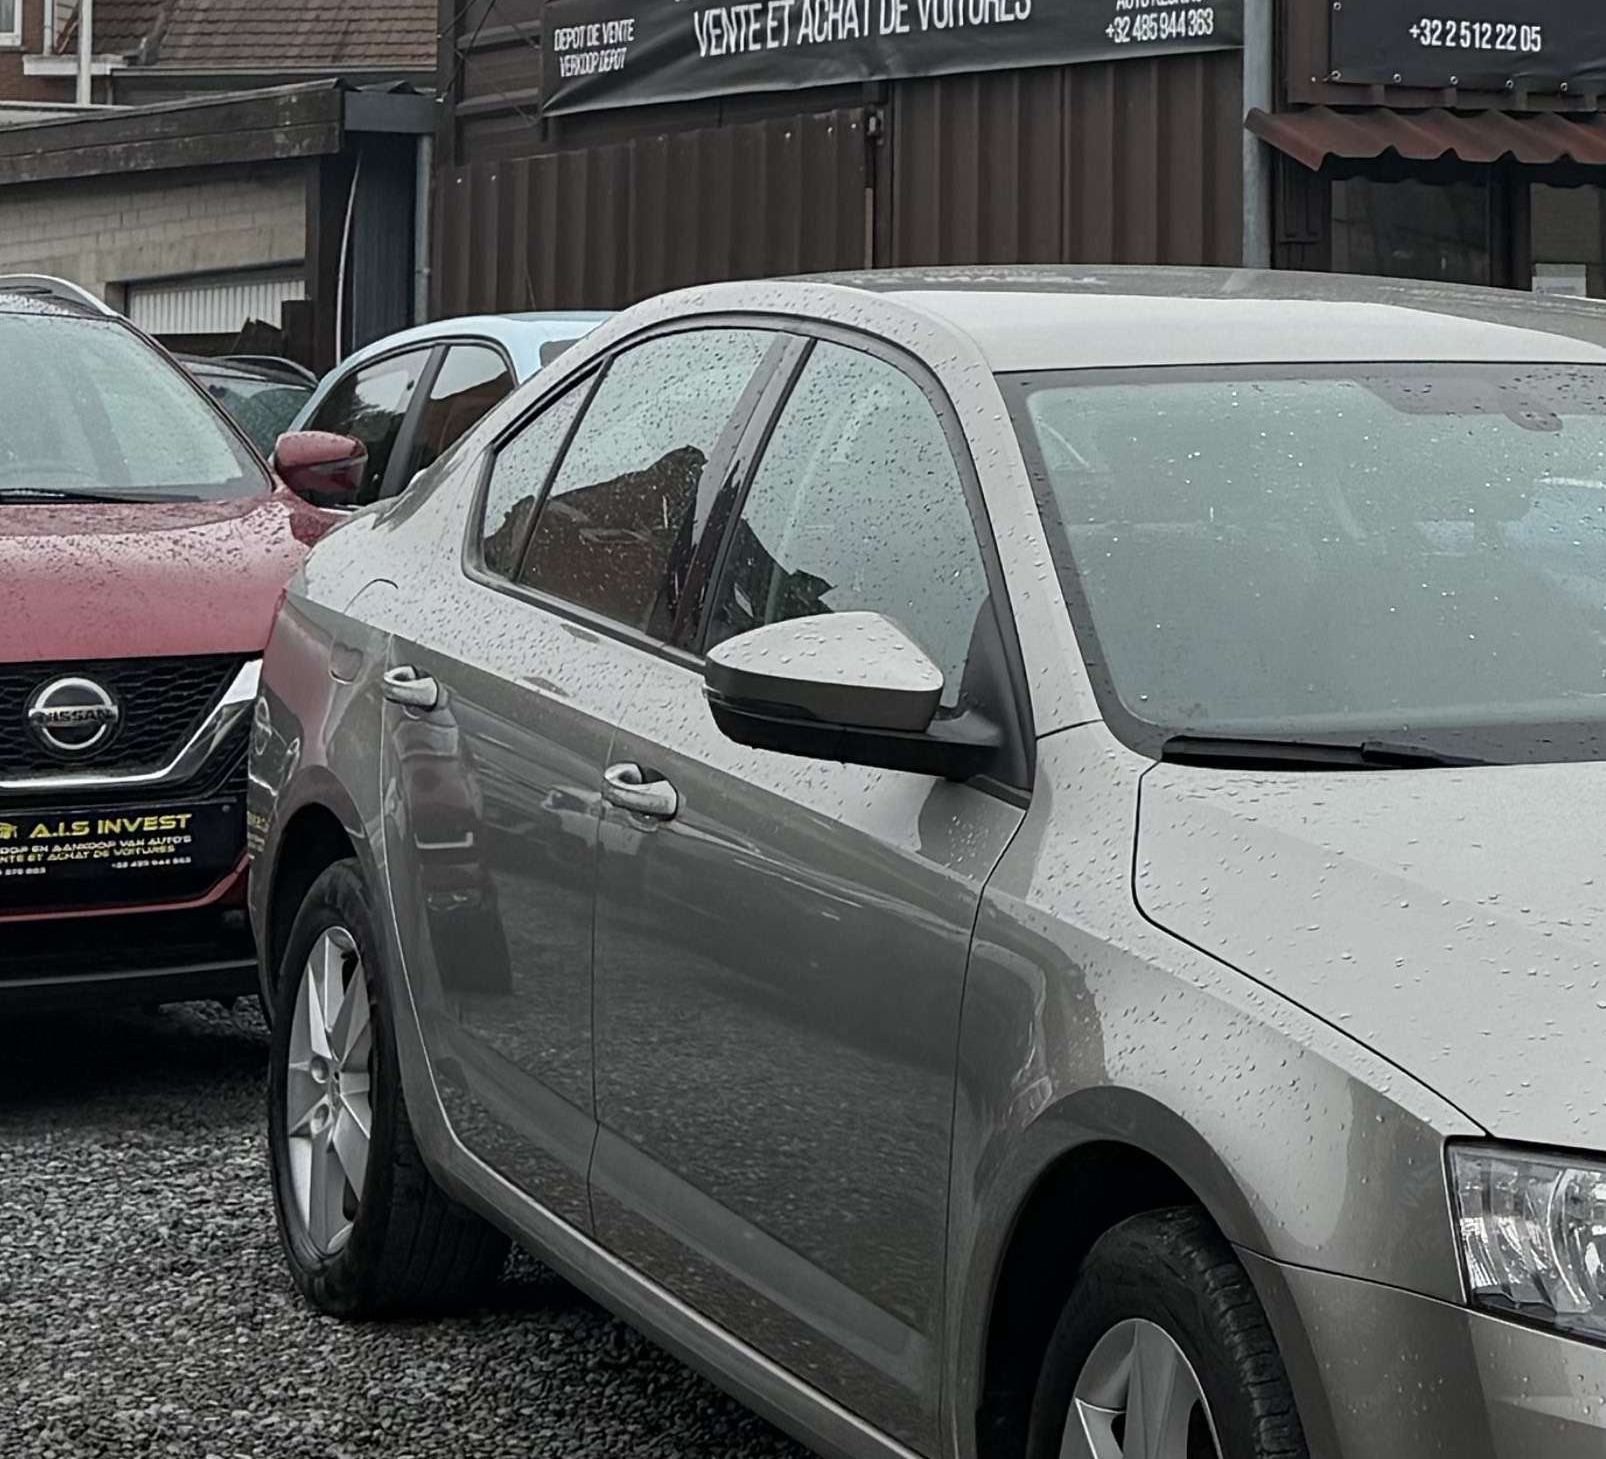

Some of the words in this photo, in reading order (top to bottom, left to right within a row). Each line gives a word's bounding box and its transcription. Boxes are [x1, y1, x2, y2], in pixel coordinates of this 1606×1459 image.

[554, 25, 586, 51] DEPOT
[587, 23, 601, 47] DE
[602, 18, 635, 44] VENTE
[694, 3, 763, 57] VENTE
[1105, 16, 1130, 43] +32
[1132, 13, 1158, 41] 485
[1187, 7, 1214, 36] 363
[1409, 18, 1442, 46] +32
[1445, 20, 1456, 47] 2
[1460, 21, 1492, 49] 512
[1495, 23, 1517, 51] 22
[1520, 25, 1541, 52] 05
[30, 821, 90, 839] A.I.S
[97, 813, 192, 835] INVEST
